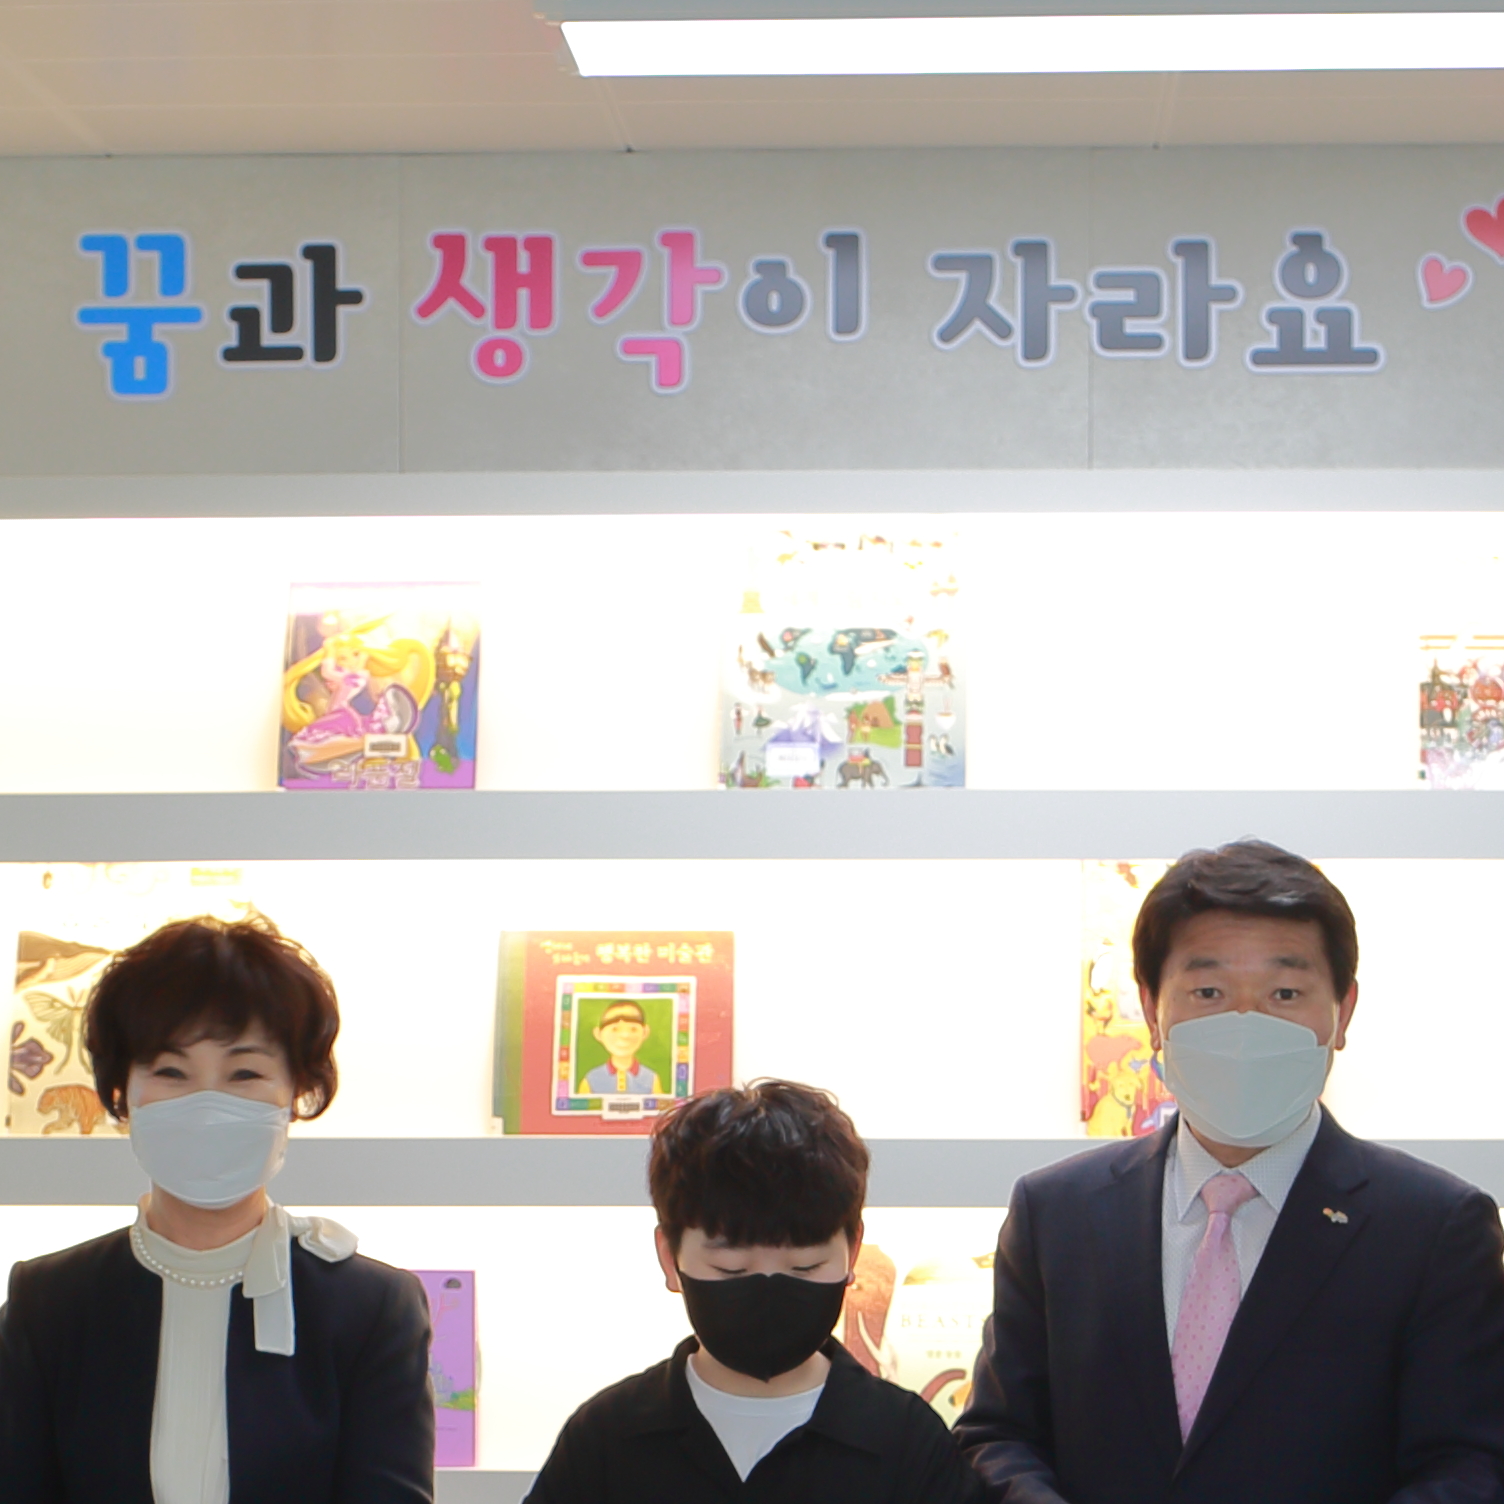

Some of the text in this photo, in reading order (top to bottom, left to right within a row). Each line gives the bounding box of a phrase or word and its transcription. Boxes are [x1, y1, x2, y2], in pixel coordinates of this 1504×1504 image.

[76, 228, 1386, 399] 꿈과 생각이 자라요
[595, 942, 653, 965] 행복한
[656, 942, 715, 965] 미술관
[900, 1313, 987, 1329] BEAST
